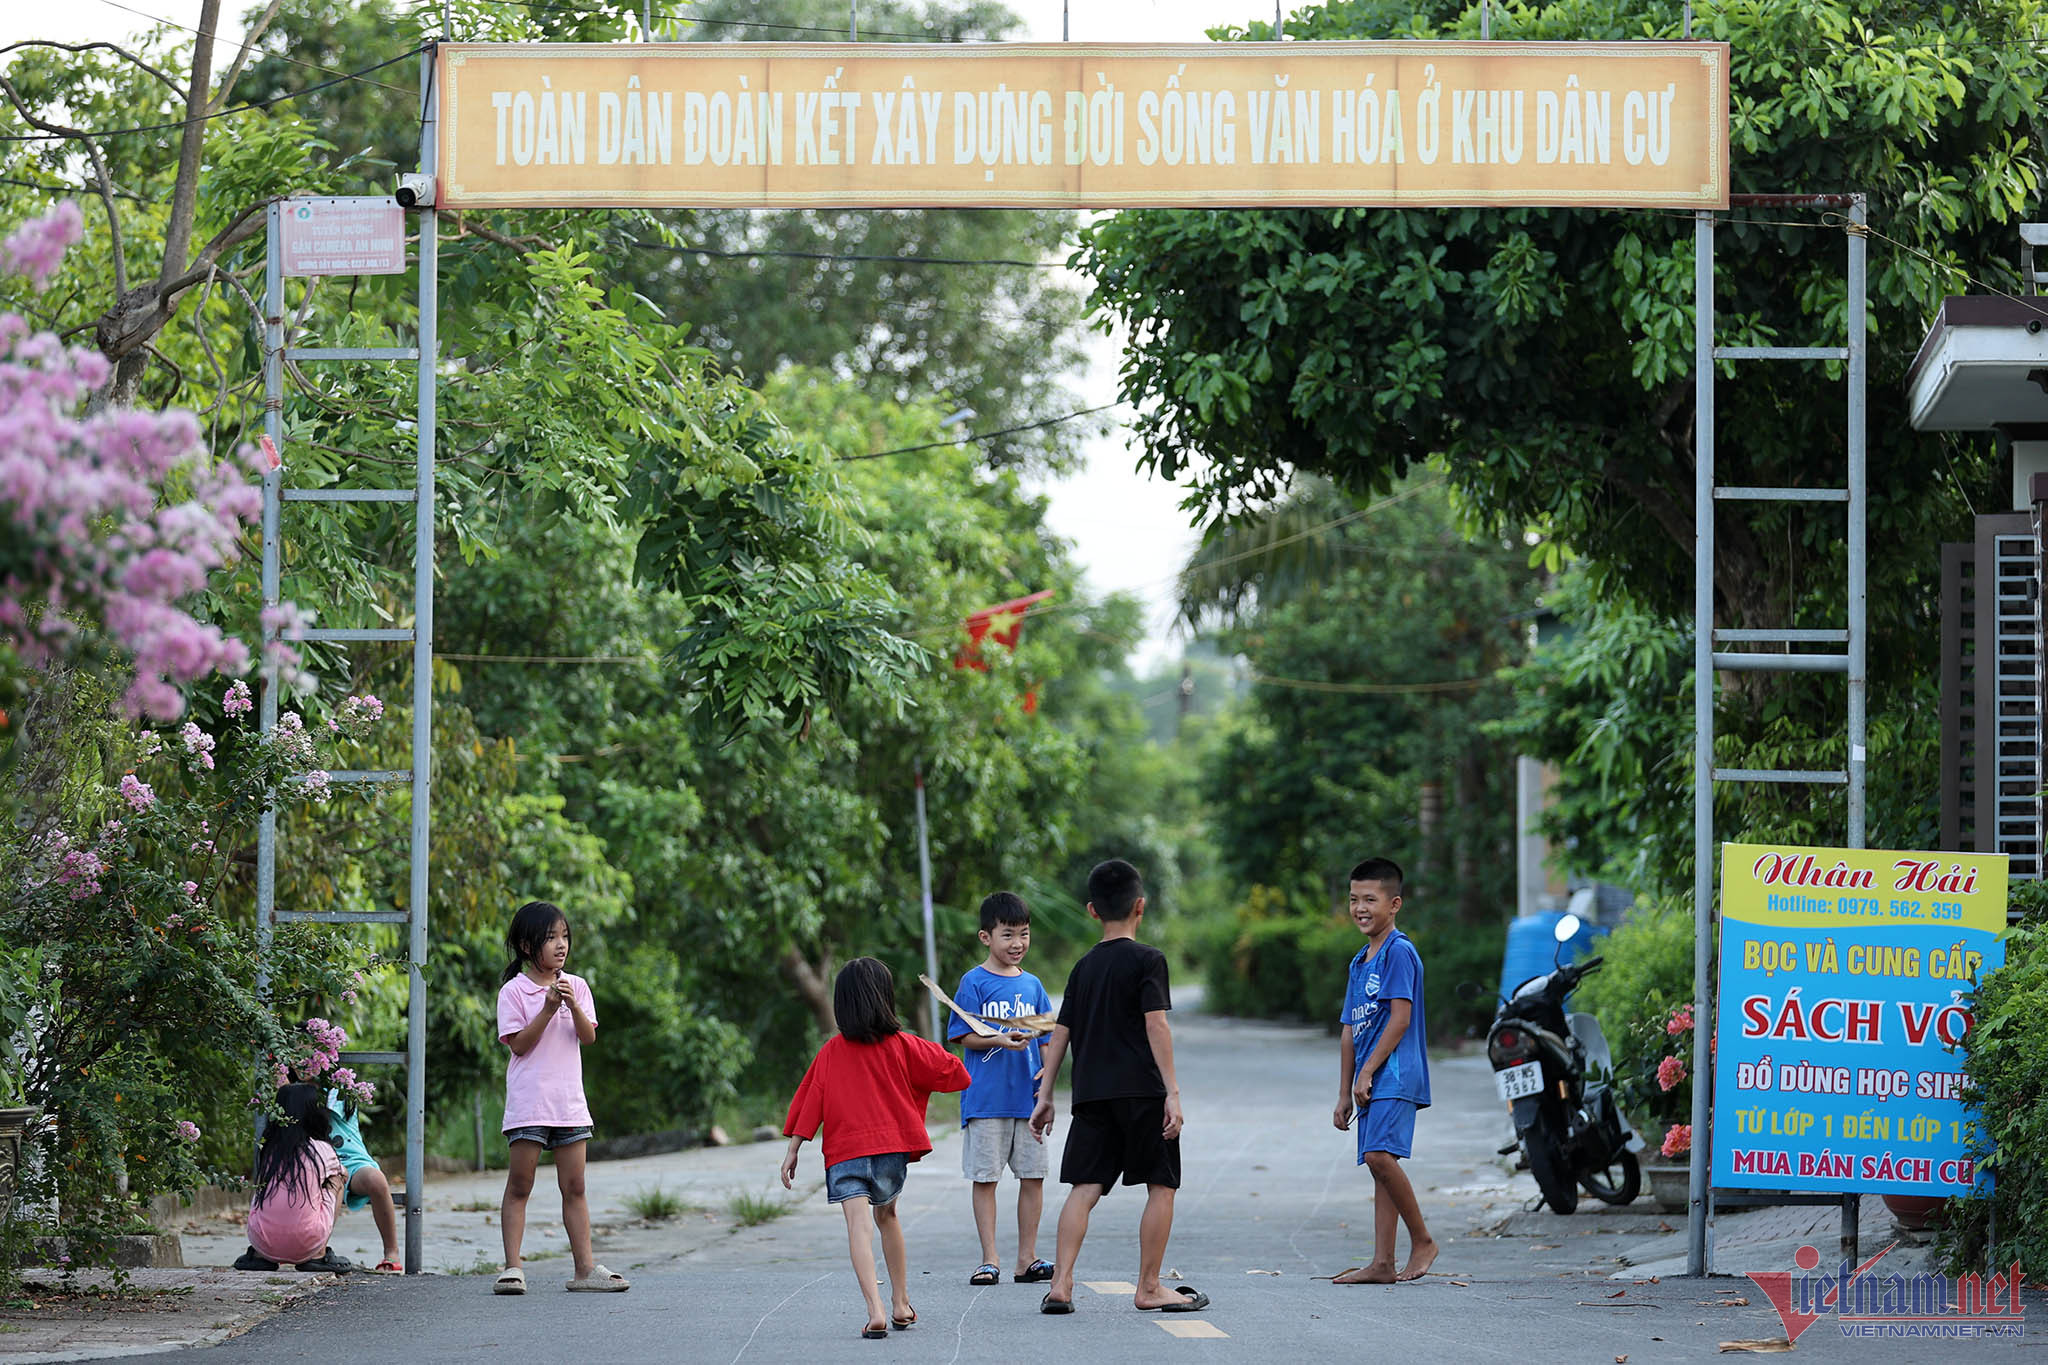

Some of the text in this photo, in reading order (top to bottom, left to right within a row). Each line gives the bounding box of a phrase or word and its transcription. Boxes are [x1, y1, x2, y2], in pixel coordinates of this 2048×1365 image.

[492, 64, 1676, 181] TOÀN DÂN ĐOÀN KẾT XÂY DỰNG ĐỜI SỐNG VĂN HÓA Ở KHU DÂN CƯ
[1753, 853, 1980, 895] Nhân Hải
[1768, 894, 1962, 920] Hotline: 0979. 562. 359
[1744, 938, 1983, 980] BỌC VÀ CUNG CẤP
[1742, 987, 1886, 1045] SÁCH
[1737, 1055, 1773, 1090] ĐỒ
[1780, 1061, 1850, 1094] DÙNG
[1857, 1069, 1909, 1102] HỌC
[1736, 1105, 1766, 1133] TỪ
[1771, 1107, 1814, 1136] LỚP
[1823, 1115, 1832, 1137] 1
[1842, 1108, 1889, 1140] ĐẾN
[1897, 1112, 1941, 1143] LỚP
[1731, 1148, 1793, 1177] MUA
[1797, 1147, 1854, 1179] BÁN
[1862, 1152, 1932, 1183] SÁCH
